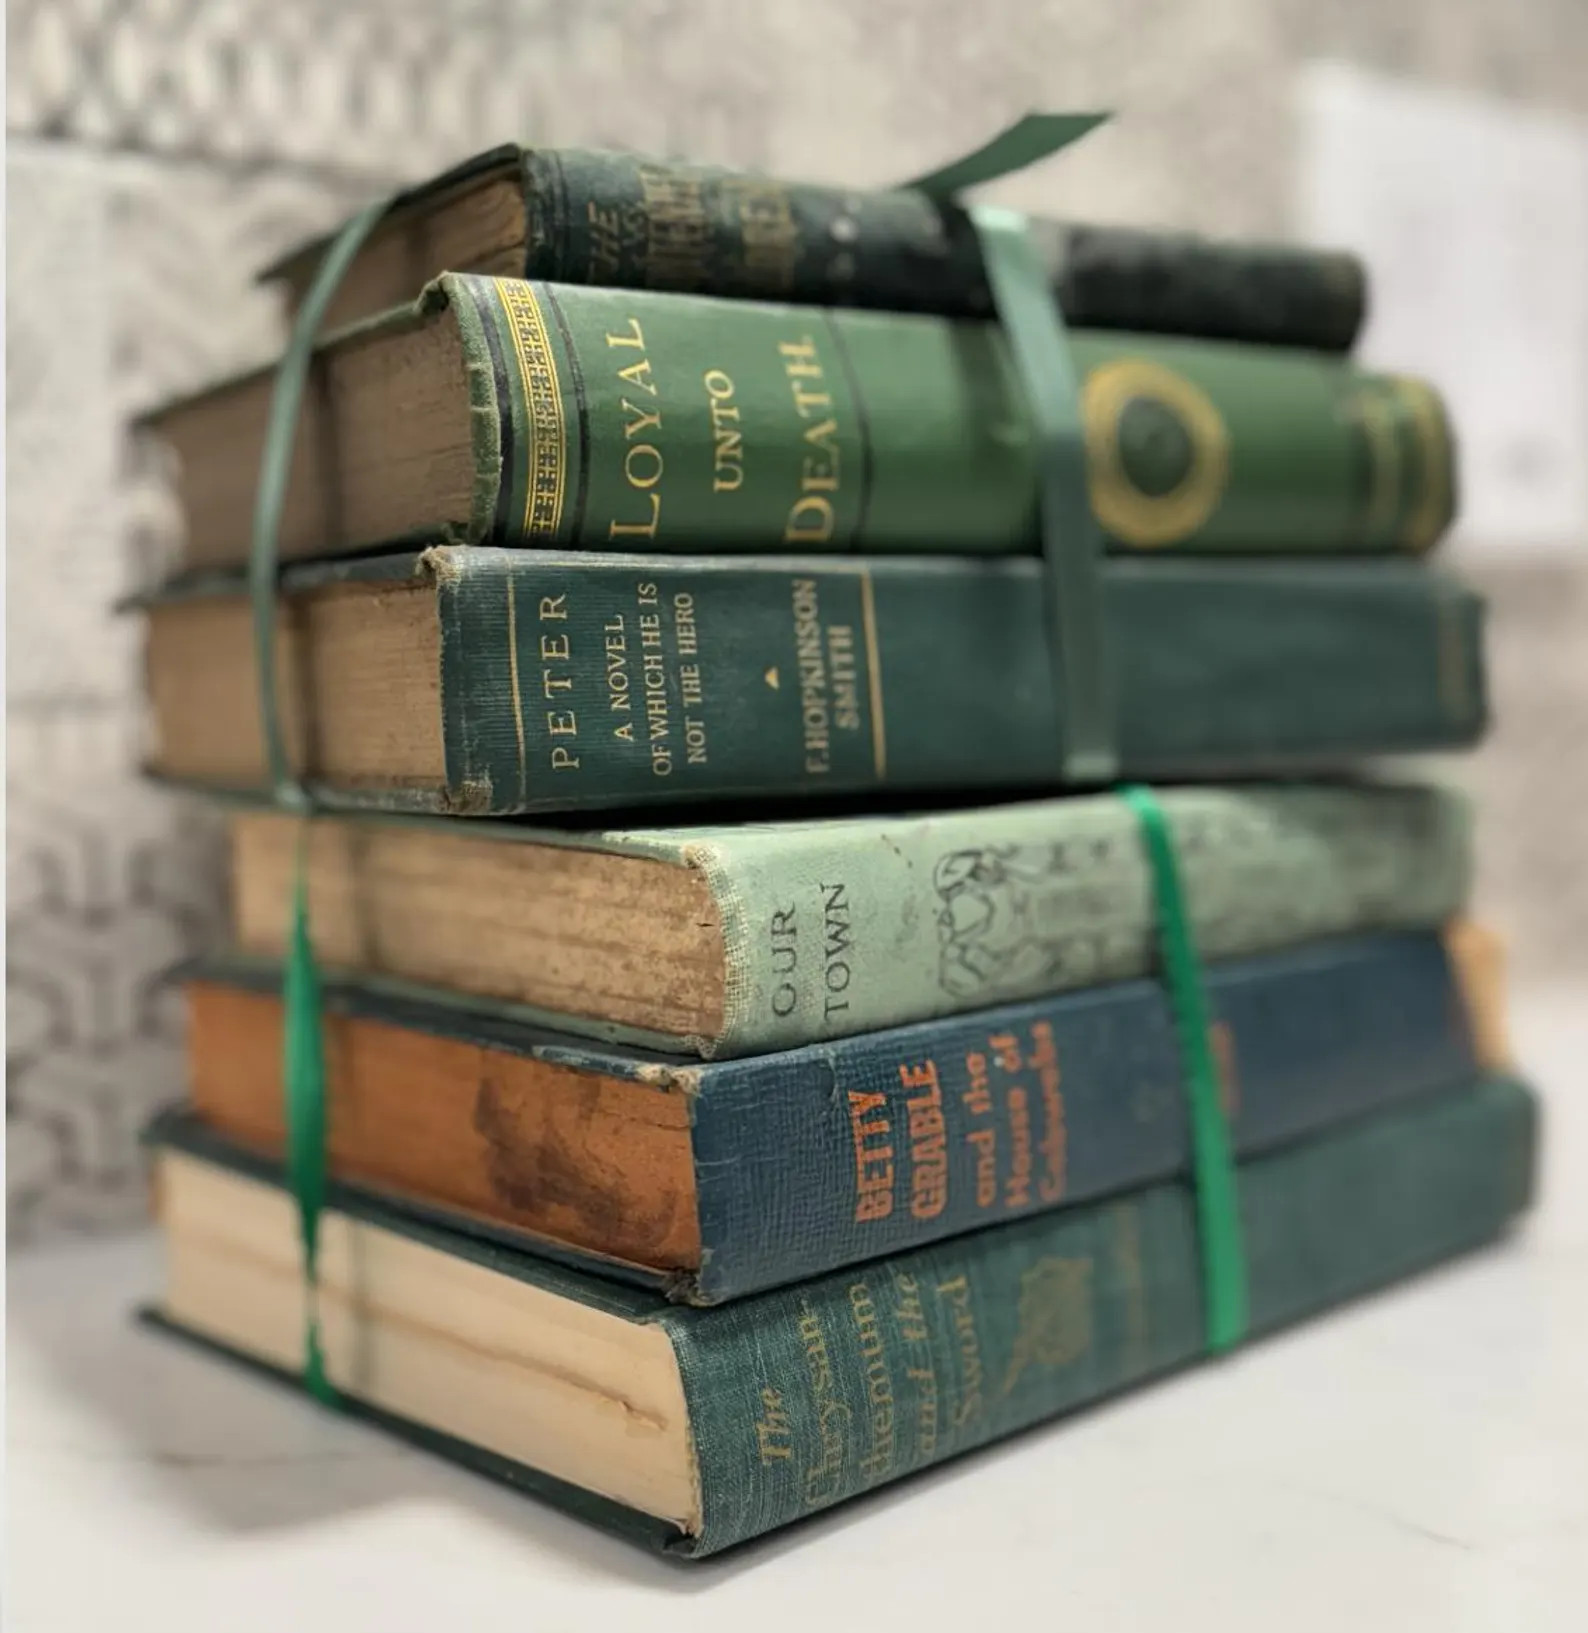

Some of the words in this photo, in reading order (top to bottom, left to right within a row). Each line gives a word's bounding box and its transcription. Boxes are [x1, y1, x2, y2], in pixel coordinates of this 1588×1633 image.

[606, 318, 663, 540] LOYAL
[704, 370, 743, 493] UNTO
[638, 582, 658, 606] IS
[640, 614, 662, 648] HE
[674, 593, 697, 655] HERO
[540, 594, 580, 769] PETER
[605, 614, 631, 711] NOVEL
[644, 655, 671, 741] WHICH
[680, 664, 702, 707] THE
[827, 625, 860, 730] SMITH
[614, 723, 634, 742] A
[653, 745, 672, 776] OF
[686, 718, 707, 763] NOT
[770, 902, 799, 1017] OUR
[821, 881, 853, 1020] TOWN
[963, 1052, 994, 1115] the
[988, 1033, 1023, 1073] of
[847, 1089, 893, 1223] BETTY
[901, 1059, 947, 1220] GRABLE
[967, 1129, 997, 1207] and
[1005, 1086, 1033, 1207] House
[895, 1273, 928, 1341] the
[936, 1274, 982, 1427] Sword
[756, 1387, 792, 1467] The
[907, 1368, 937, 1455] and
